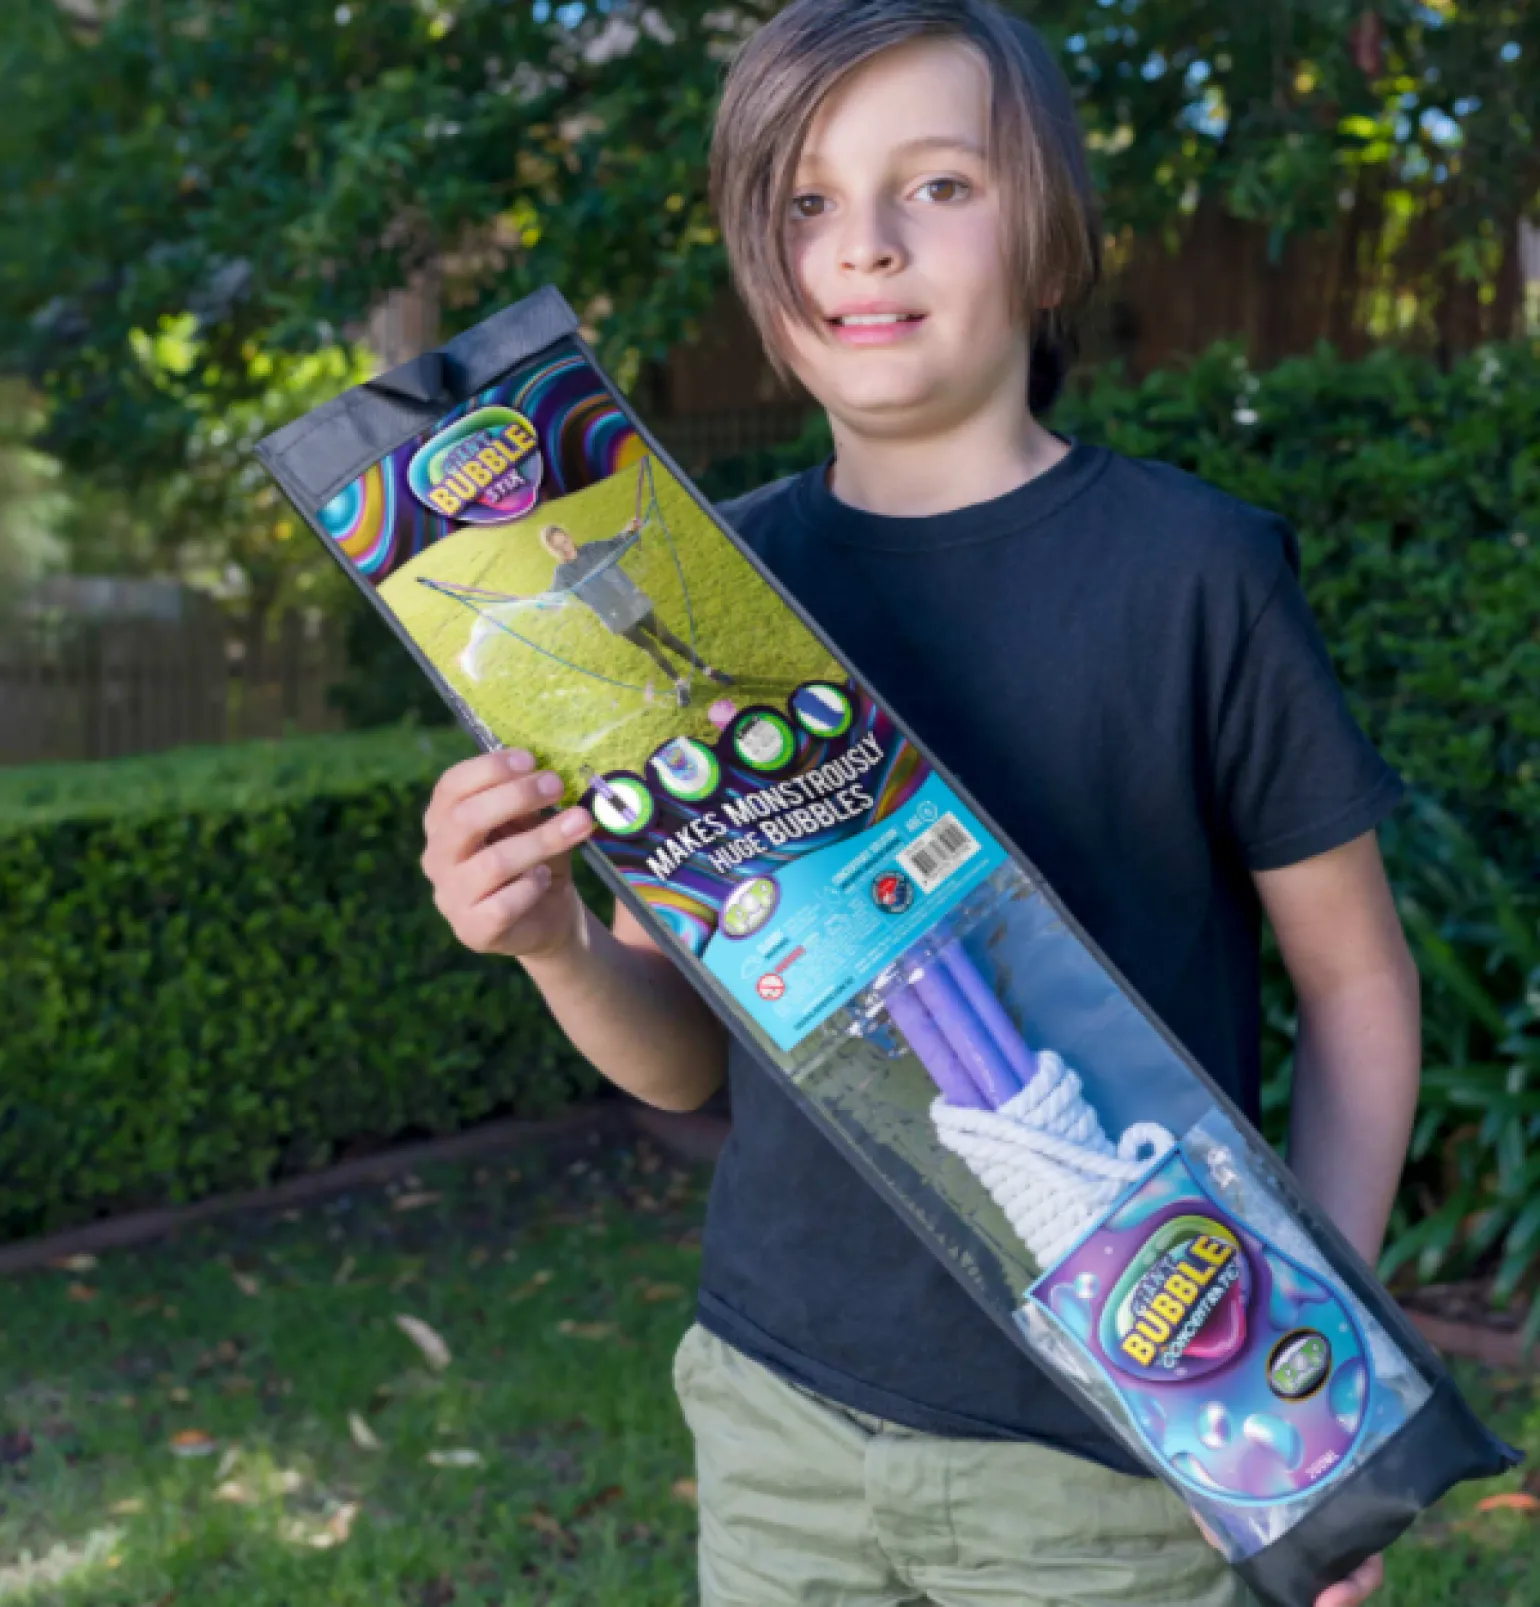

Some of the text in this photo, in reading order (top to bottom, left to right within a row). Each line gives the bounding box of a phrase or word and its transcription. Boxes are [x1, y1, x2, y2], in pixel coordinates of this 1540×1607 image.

[428, 424, 537, 516] BUBBLE
[485, 468, 526, 503] STIX
[646, 731, 884, 881] MAKES MONSTROUSLY
[709, 783, 874, 873] HUGE BUBBLES
[1121, 1234, 1233, 1368] BUBBLE
